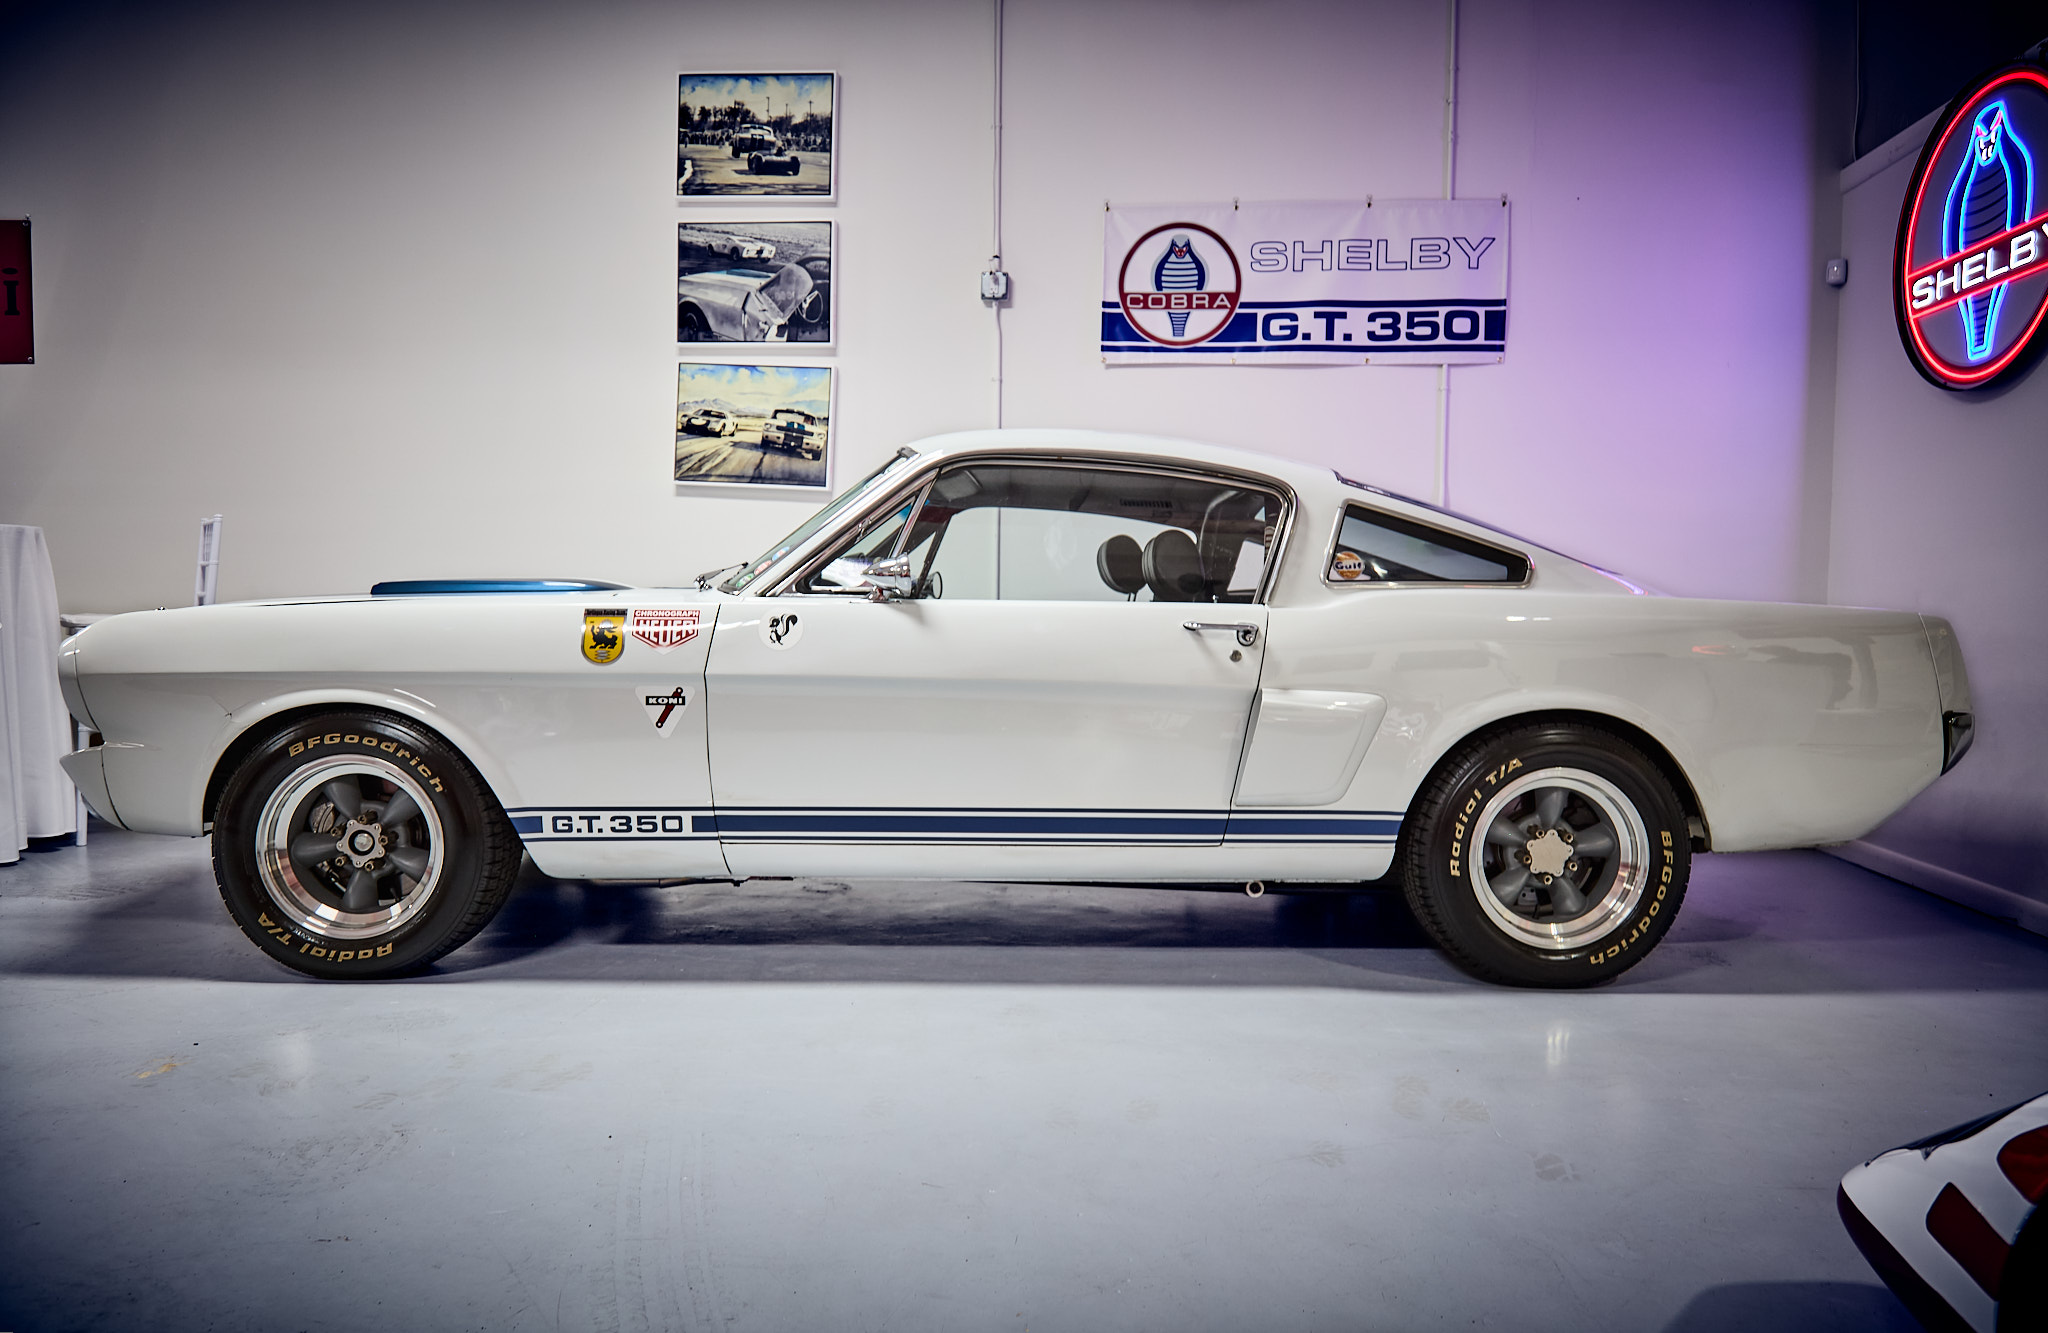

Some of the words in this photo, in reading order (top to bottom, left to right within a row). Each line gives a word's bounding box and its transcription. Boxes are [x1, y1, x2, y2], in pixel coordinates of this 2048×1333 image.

[1250, 237, 1496, 272] SHELBY
[1911, 221, 2048, 310] SHELB
[1126, 293, 1232, 309] COBRA
[1261, 311, 1353, 342] G.T.
[1366, 310, 1480, 342] 350
[1334, 561, 1363, 570] Gulf
[638, 619, 695, 646] HEUER
[648, 697, 683, 705] KONI
[288, 733, 444, 794] BFGoodrich
[551, 815, 604, 833] G.T.
[610, 815, 683, 833] 350
[1450, 788, 1483, 877] Radial
[1485, 757, 1523, 786] T/A
[1590, 830, 1673, 965] BFGoodrich
[257, 911, 291, 947] T/A
[299, 942, 393, 962] Radial
